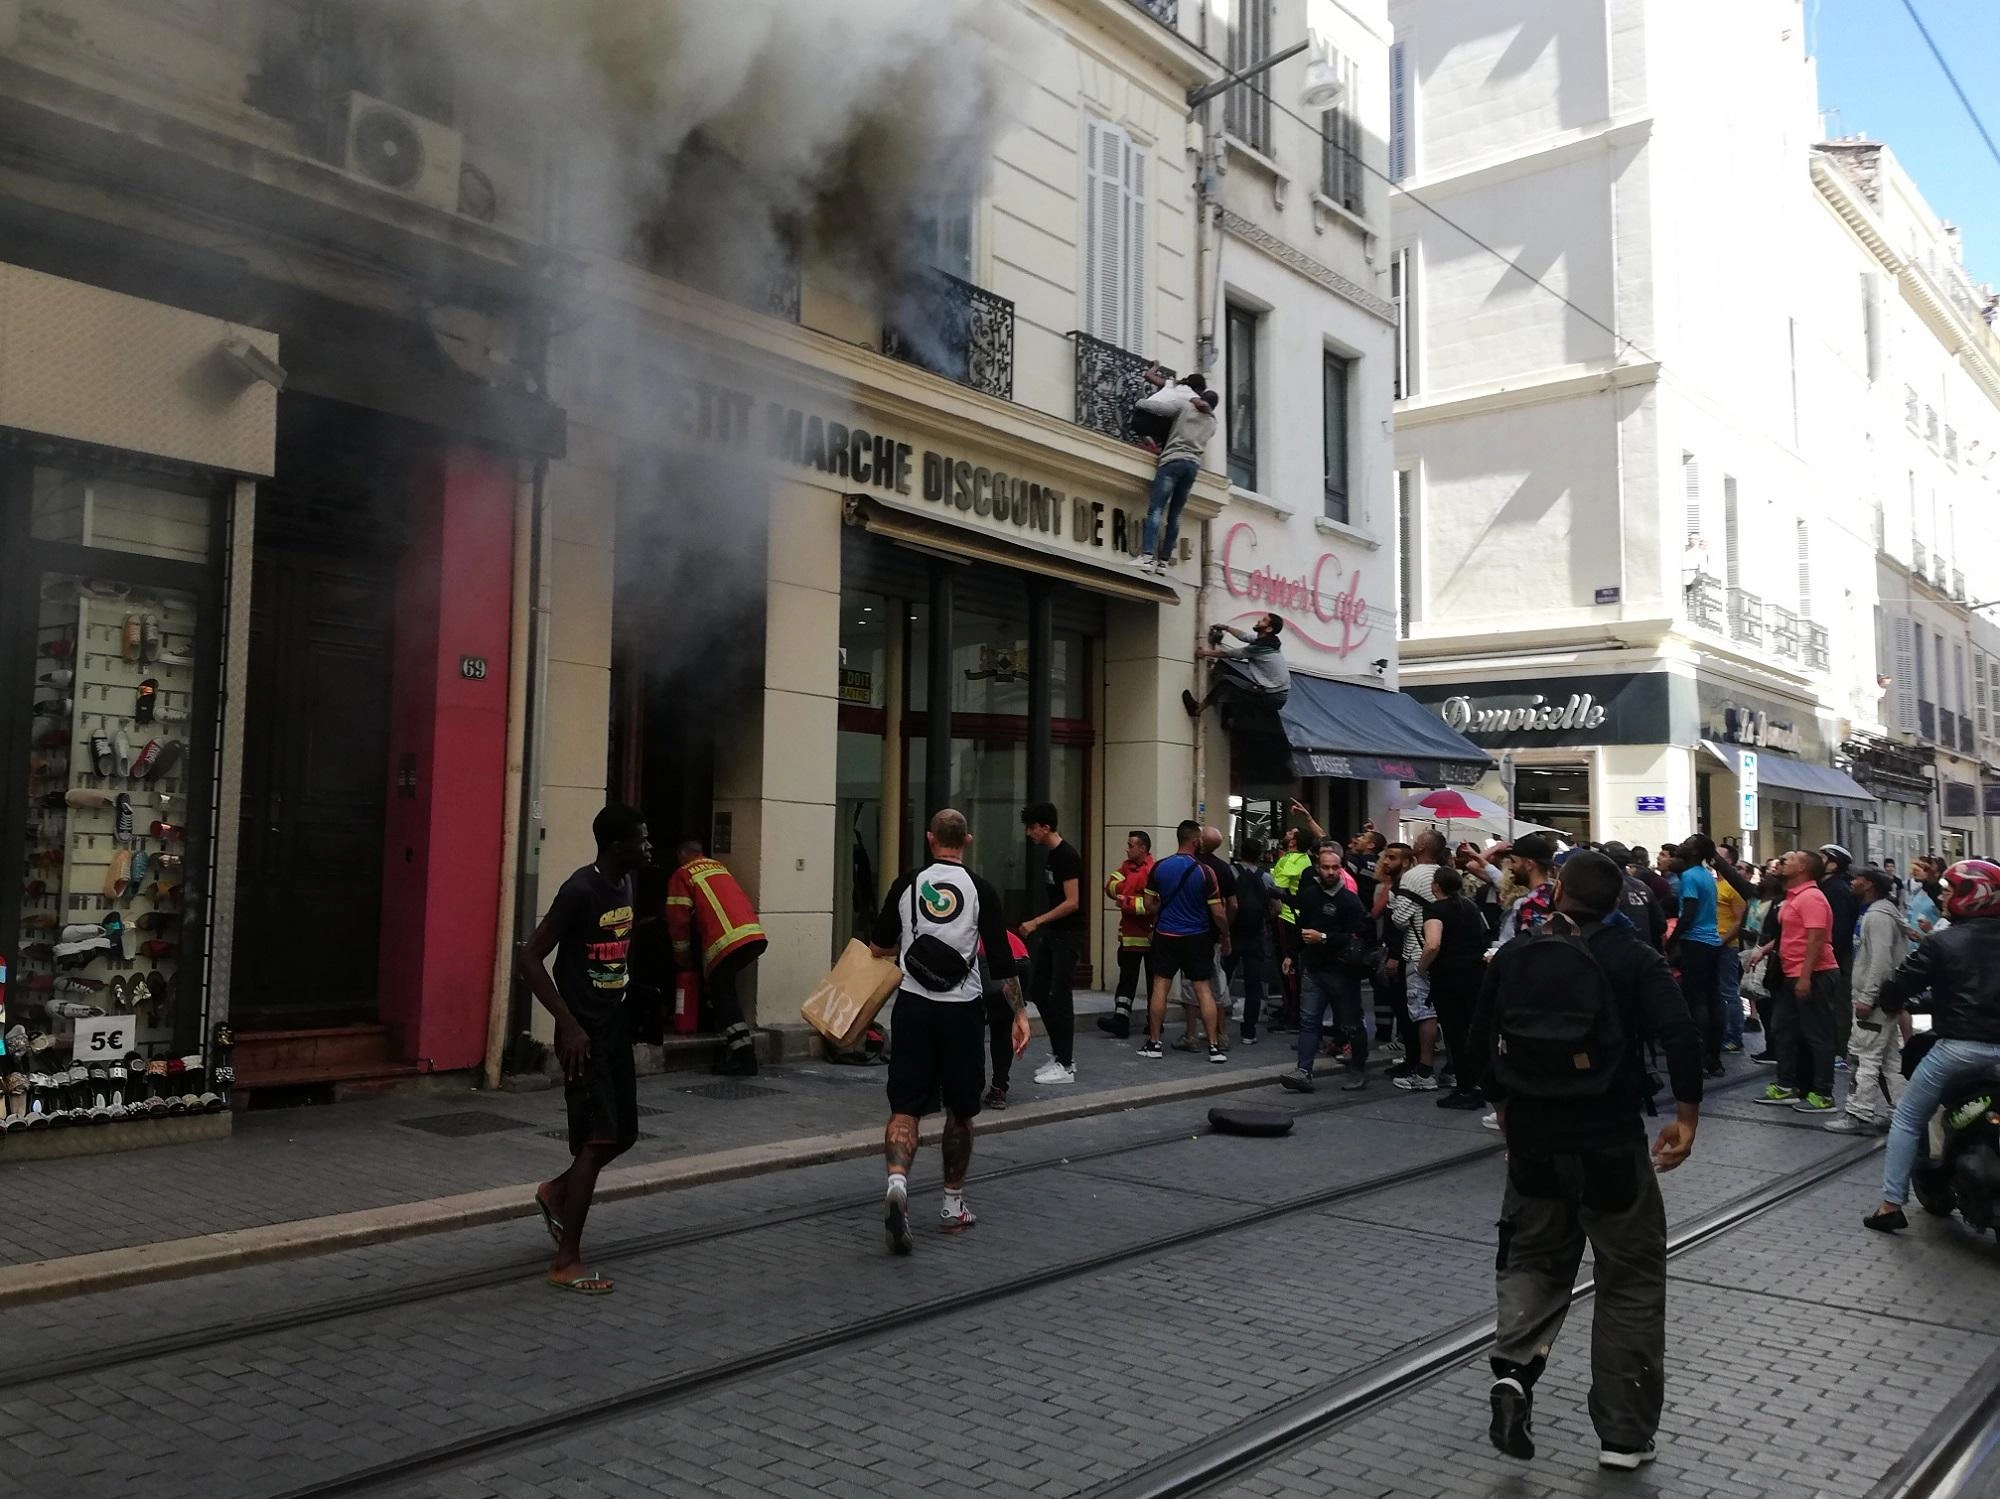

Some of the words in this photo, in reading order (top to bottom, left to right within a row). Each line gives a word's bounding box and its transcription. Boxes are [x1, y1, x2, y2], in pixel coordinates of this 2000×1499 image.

[766, 400, 913, 496] MARCHE
[923, 450, 1067, 536] DISCOUNT
[1072, 496, 1105, 547] DE
[463, 658, 486, 679] 69
[1441, 693, 1607, 735] Demoiselle
[90, 1030, 123, 1051] 5€
